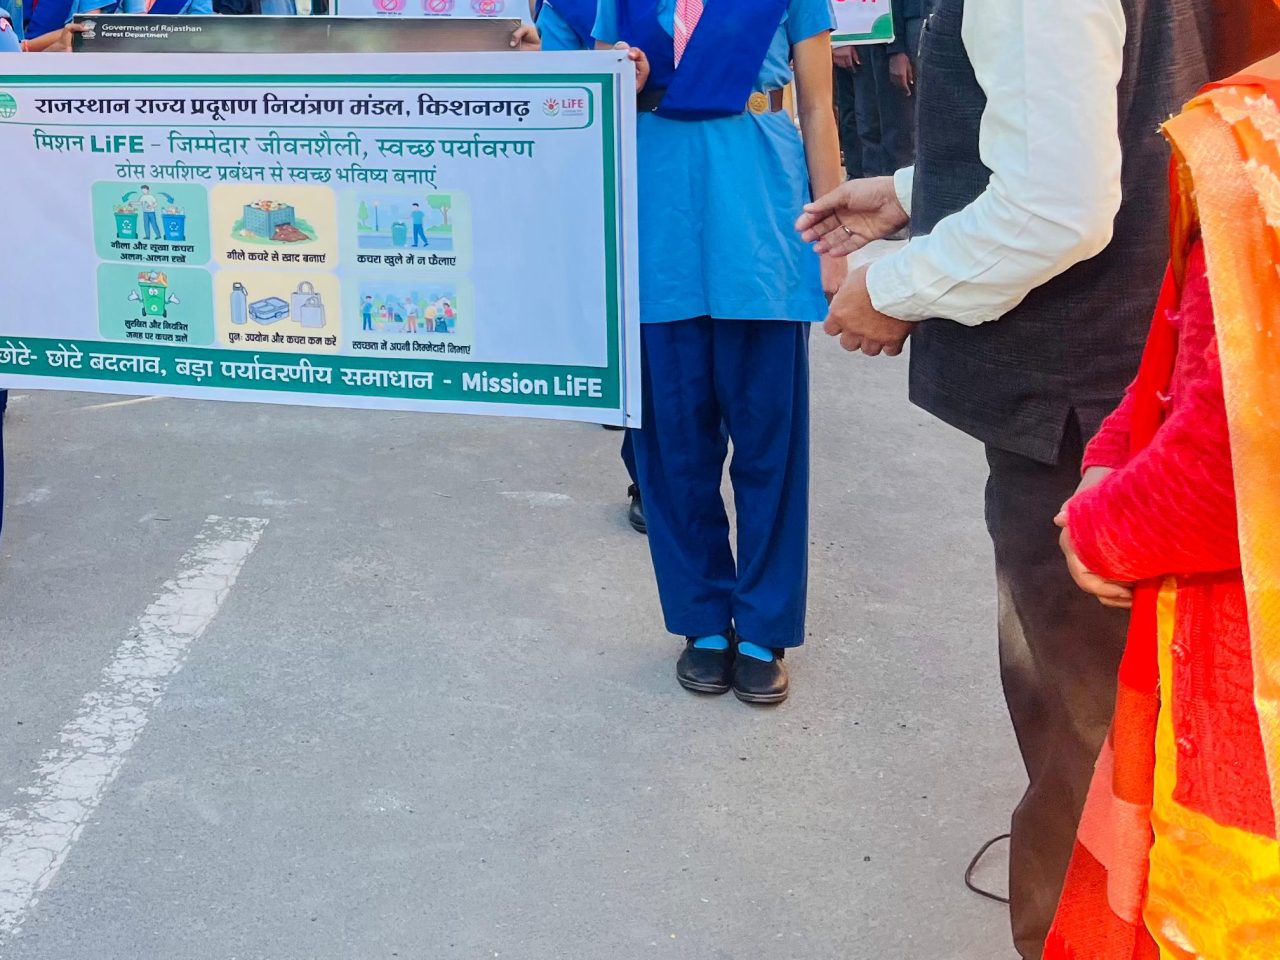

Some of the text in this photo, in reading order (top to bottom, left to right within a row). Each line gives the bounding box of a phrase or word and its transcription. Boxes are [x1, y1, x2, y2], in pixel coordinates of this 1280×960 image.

[35, 98, 130, 114] राजस्थान
[135, 98, 184, 114] राज्य
[190, 98, 257, 121] प्रदूषण
[262, 93, 344, 115] नियंत्रण
[349, 93, 411, 118] मंडल,
[417, 93, 531, 123] किशनगढ़
[561, 99, 584, 108] LiFE
[33, 128, 84, 152] मिशन
[91, 135, 145, 153] LiFE
[167, 130, 250, 155] जिम्मेदार
[257, 130, 368, 159] जीवनशैली,
[376, 139, 435, 158] स्वच्छ
[438, 133, 535, 159] पर्यावरण
[115, 160, 438, 189] ठोस अपशिष्ट प्रबंधन से स्वच्छ भविष्य बनाएं
[133, 241, 147, 250] और
[171, 244, 194, 253] कचरा
[120, 253, 169, 262] अलग-अलग
[227, 249, 245, 260] गीले
[248, 250, 269, 262] कचरे
[271, 250, 279, 261] से
[282, 252, 300, 263] खाद
[357, 253, 456, 266] कचरा खुले में न फैलाएं
[245, 332, 269, 343] उपयोग
[271, 331, 284, 343] और
[286, 334, 306, 345] कचरा
[308, 336, 323, 345] कम
[390, 340, 410, 352] अपनी
[412, 341, 446, 354] जिम्मेदारी
[46, 344, 83, 369] छोटे
[89, 352, 167, 378] बदलाव,
[175, 357, 213, 382] बड़ा
[220, 355, 333, 386] पर्यावरणीय
[340, 367, 433, 390] समाधान
[462, 372, 548, 395] Mission
[554, 375, 602, 398] LiFE
